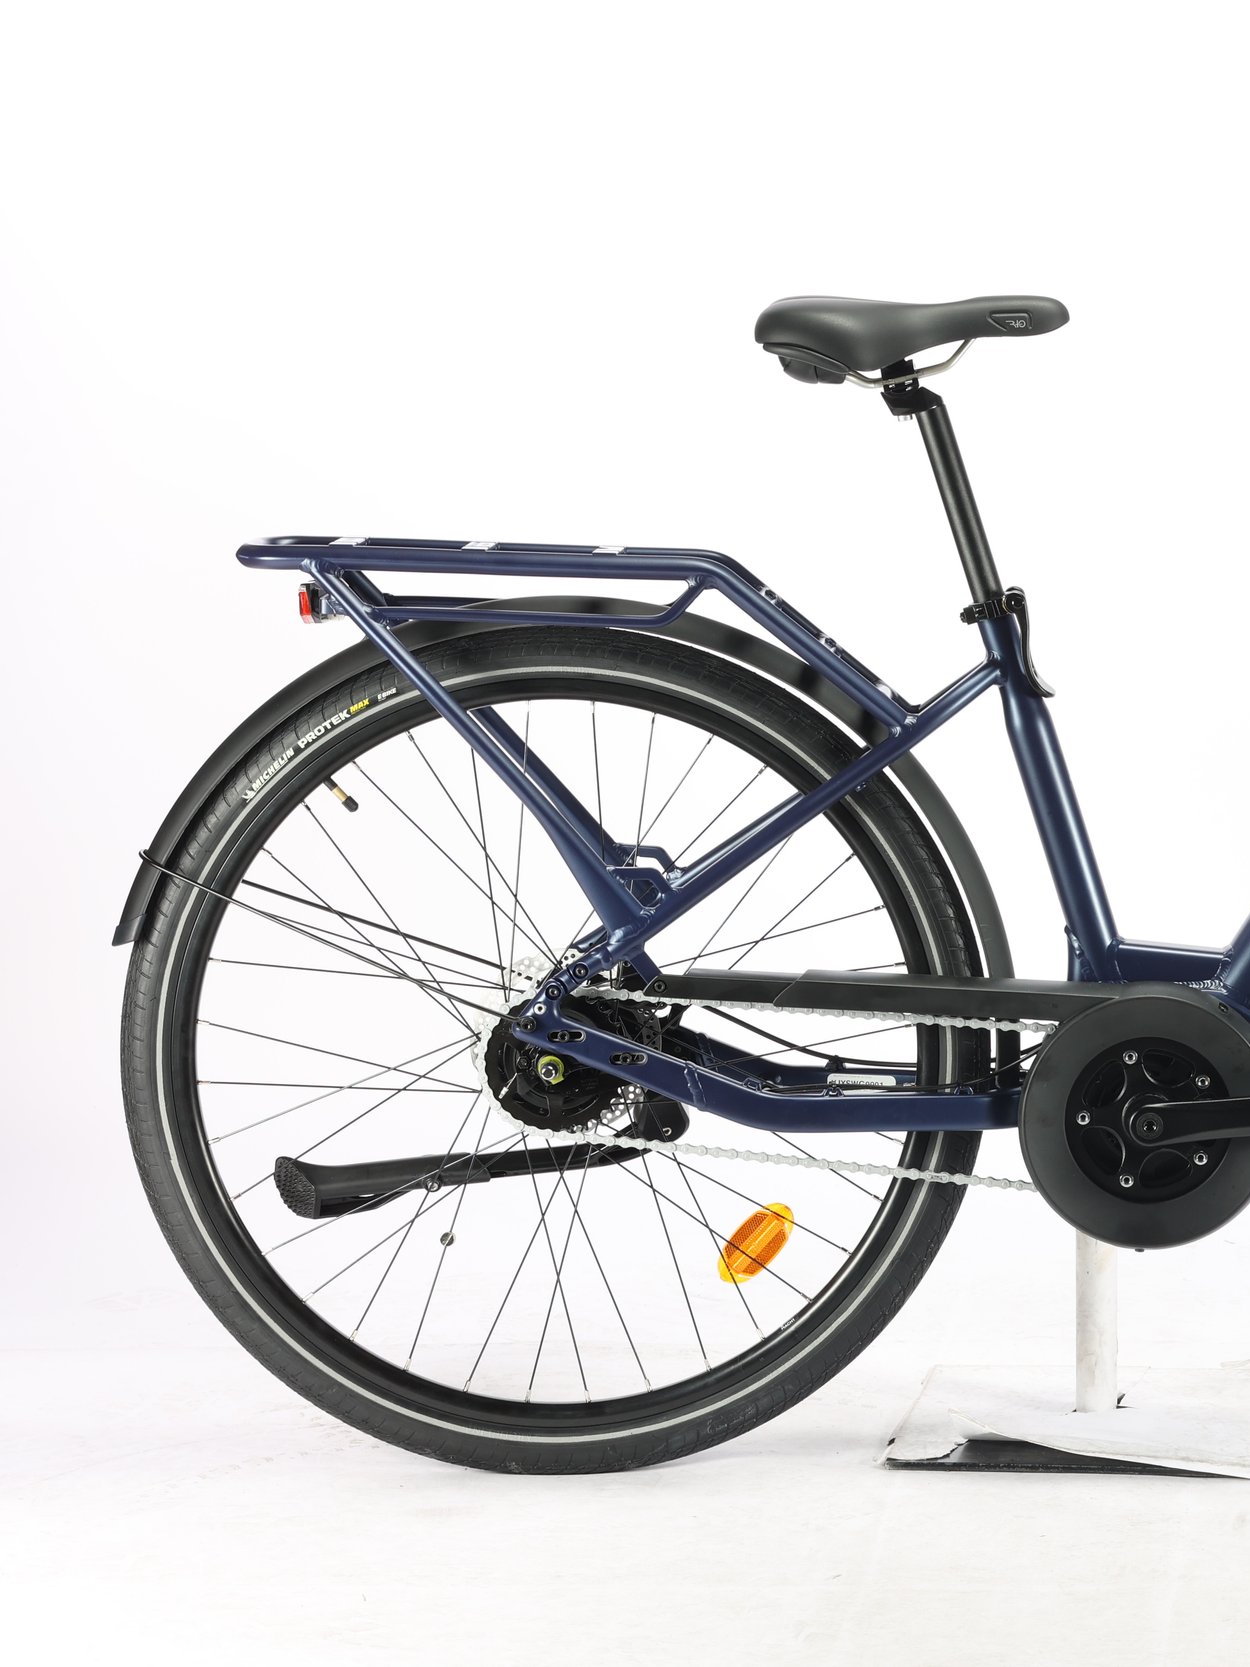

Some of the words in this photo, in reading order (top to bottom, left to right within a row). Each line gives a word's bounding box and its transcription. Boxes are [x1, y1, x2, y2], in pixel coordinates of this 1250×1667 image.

[252, 748, 294, 789] MICHELIN
[297, 709, 351, 749] PROTEK
[349, 698, 369, 714] MAX
